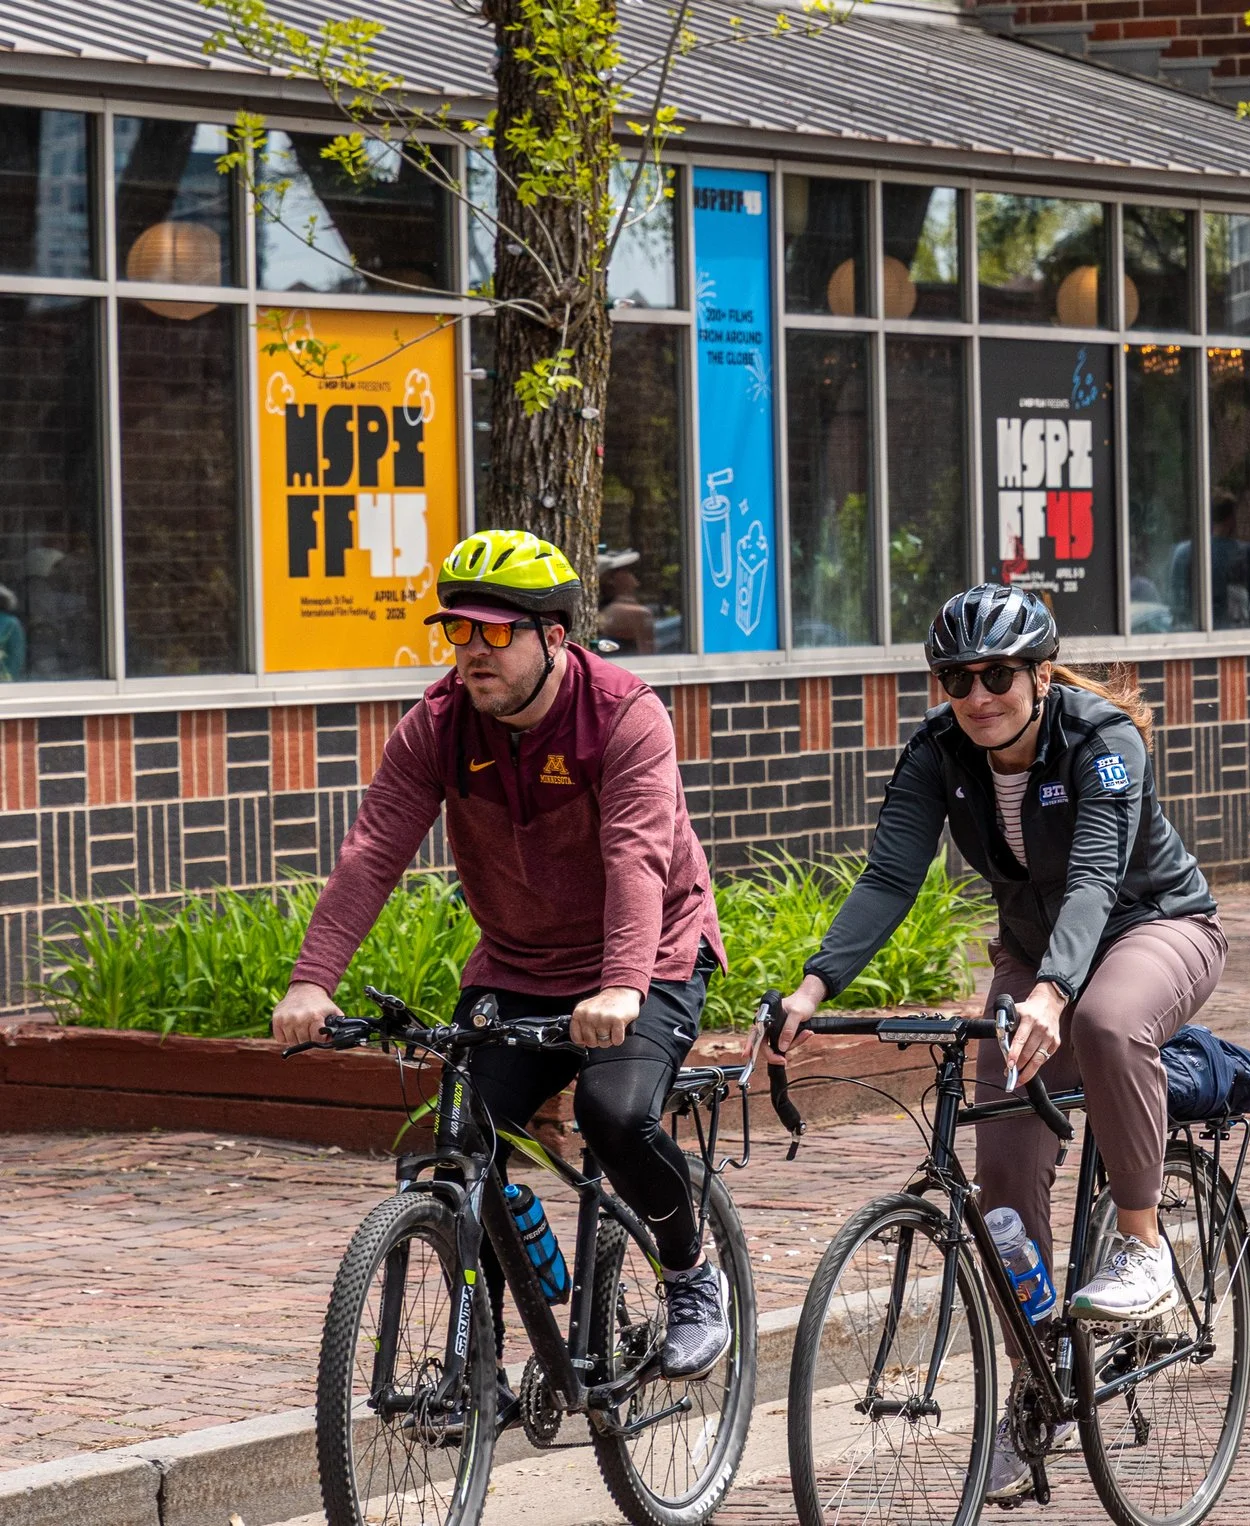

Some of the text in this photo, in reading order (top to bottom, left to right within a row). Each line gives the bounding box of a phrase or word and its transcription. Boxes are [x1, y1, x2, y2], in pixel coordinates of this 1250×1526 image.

[728, 308, 754, 324] FILMS
[698, 328, 762, 345] FROM AROUND
[706, 350, 755, 366] THE GLOBE
[998, 490, 1094, 560] FF45
[286, 492, 428, 578] FF45
[374, 590, 398, 603] APRIL
[540, 775, 573, 784] MINNESOTA
[1100, 766, 1125, 782] 10
[450, 1081, 463, 1138] NORTHROCK
[455, 1286, 474, 1356] SR SUNTOUR
[694, 1461, 733, 1515] MAXXIS
